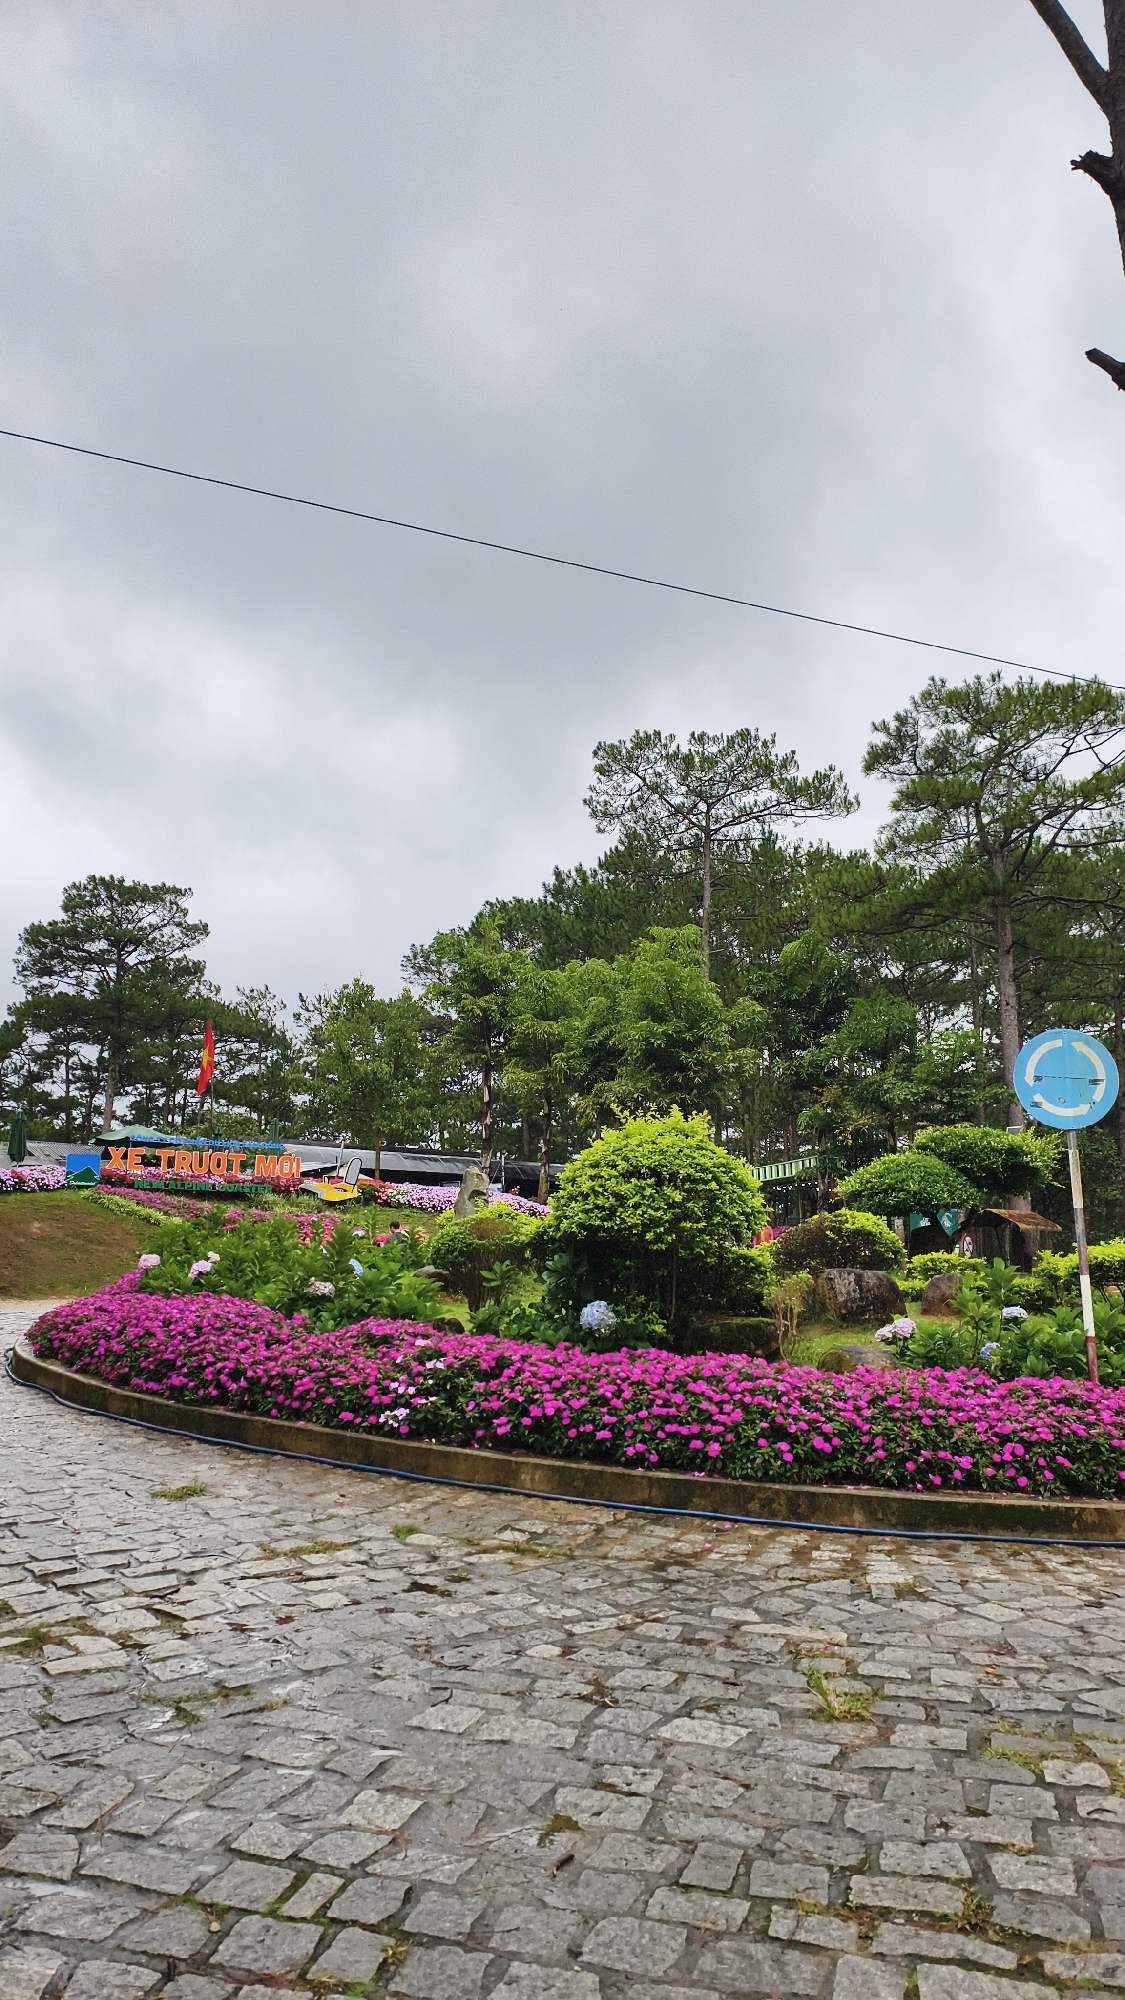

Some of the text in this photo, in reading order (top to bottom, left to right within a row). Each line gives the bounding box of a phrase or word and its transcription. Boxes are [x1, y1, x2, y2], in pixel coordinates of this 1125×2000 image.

[105, 1147, 144, 1170] XE
[255, 1149, 301, 1178] MỚI
[134, 1180, 272, 1194] NEW ALPINE COASTER
